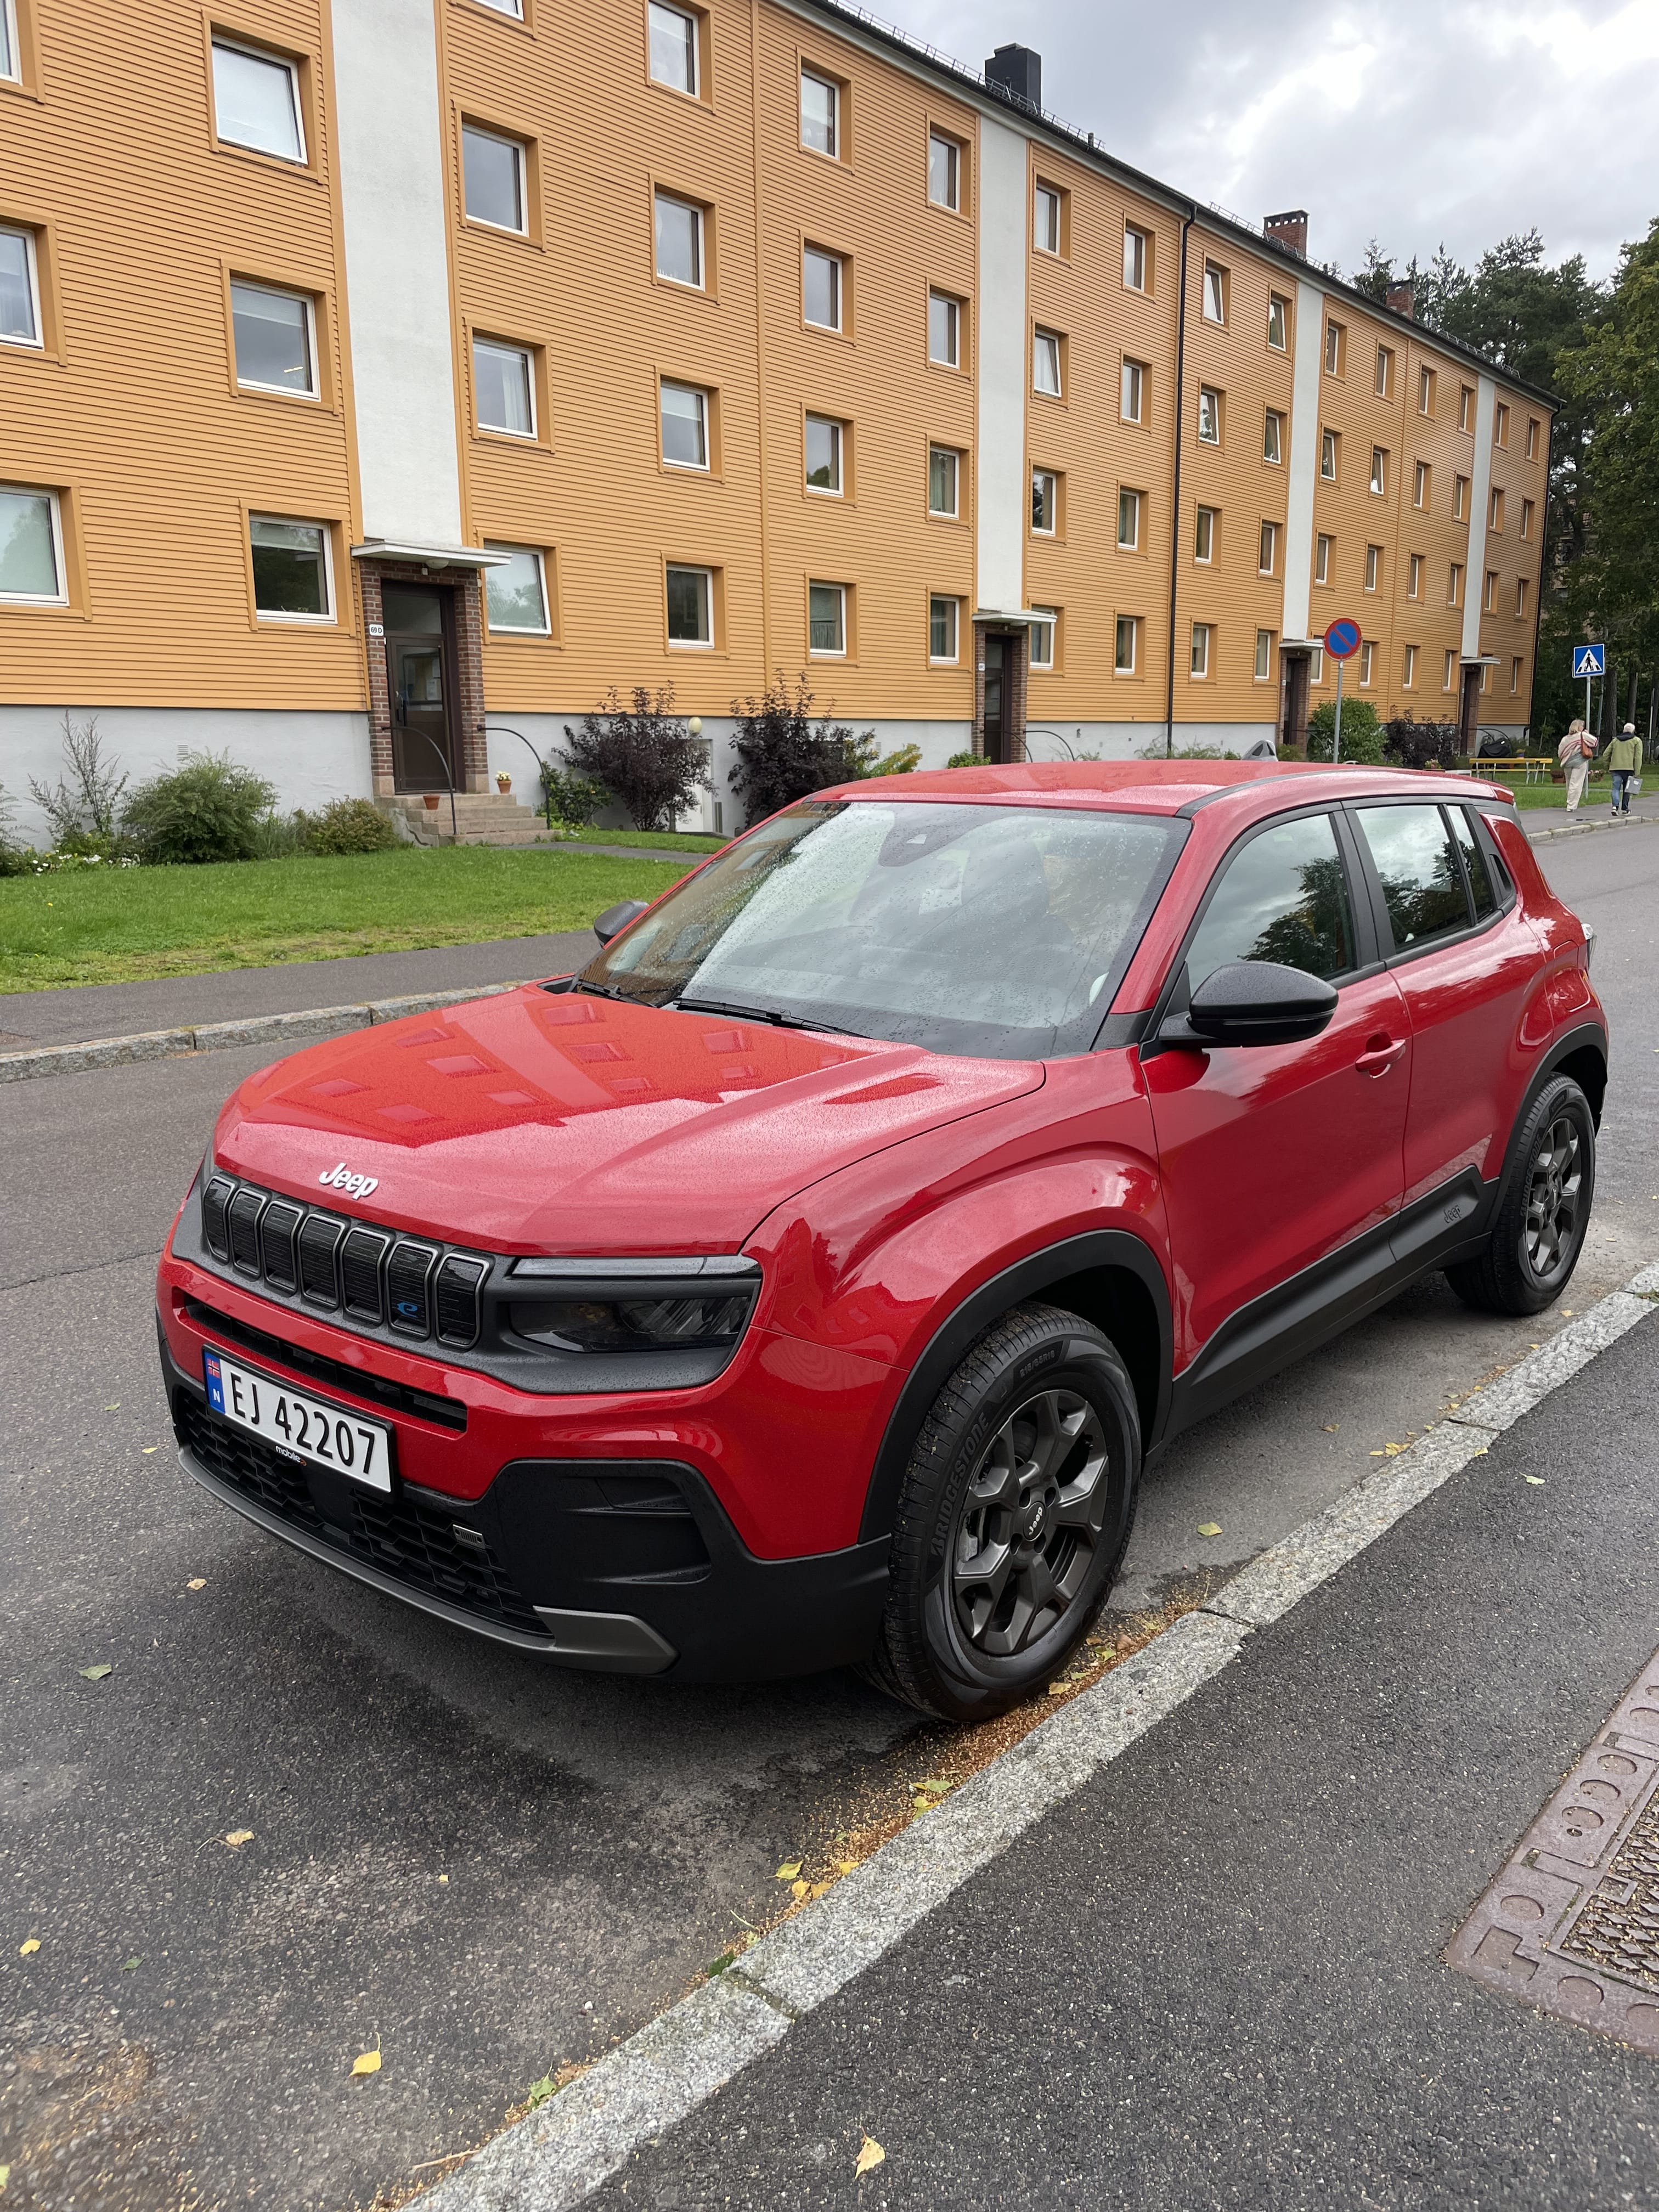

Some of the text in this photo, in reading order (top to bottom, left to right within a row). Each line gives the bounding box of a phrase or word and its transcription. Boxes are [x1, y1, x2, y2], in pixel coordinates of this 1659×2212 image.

[319, 1163, 379, 1200] Jeep
[1443, 1205, 1462, 1224] Jeep
[212, 1388, 221, 1403] N
[230, 1372, 375, 1475] EJ 42207
[930, 1412, 989, 1557] BRIDGESTONE
[1028, 1506, 1043, 1536] Jeep
